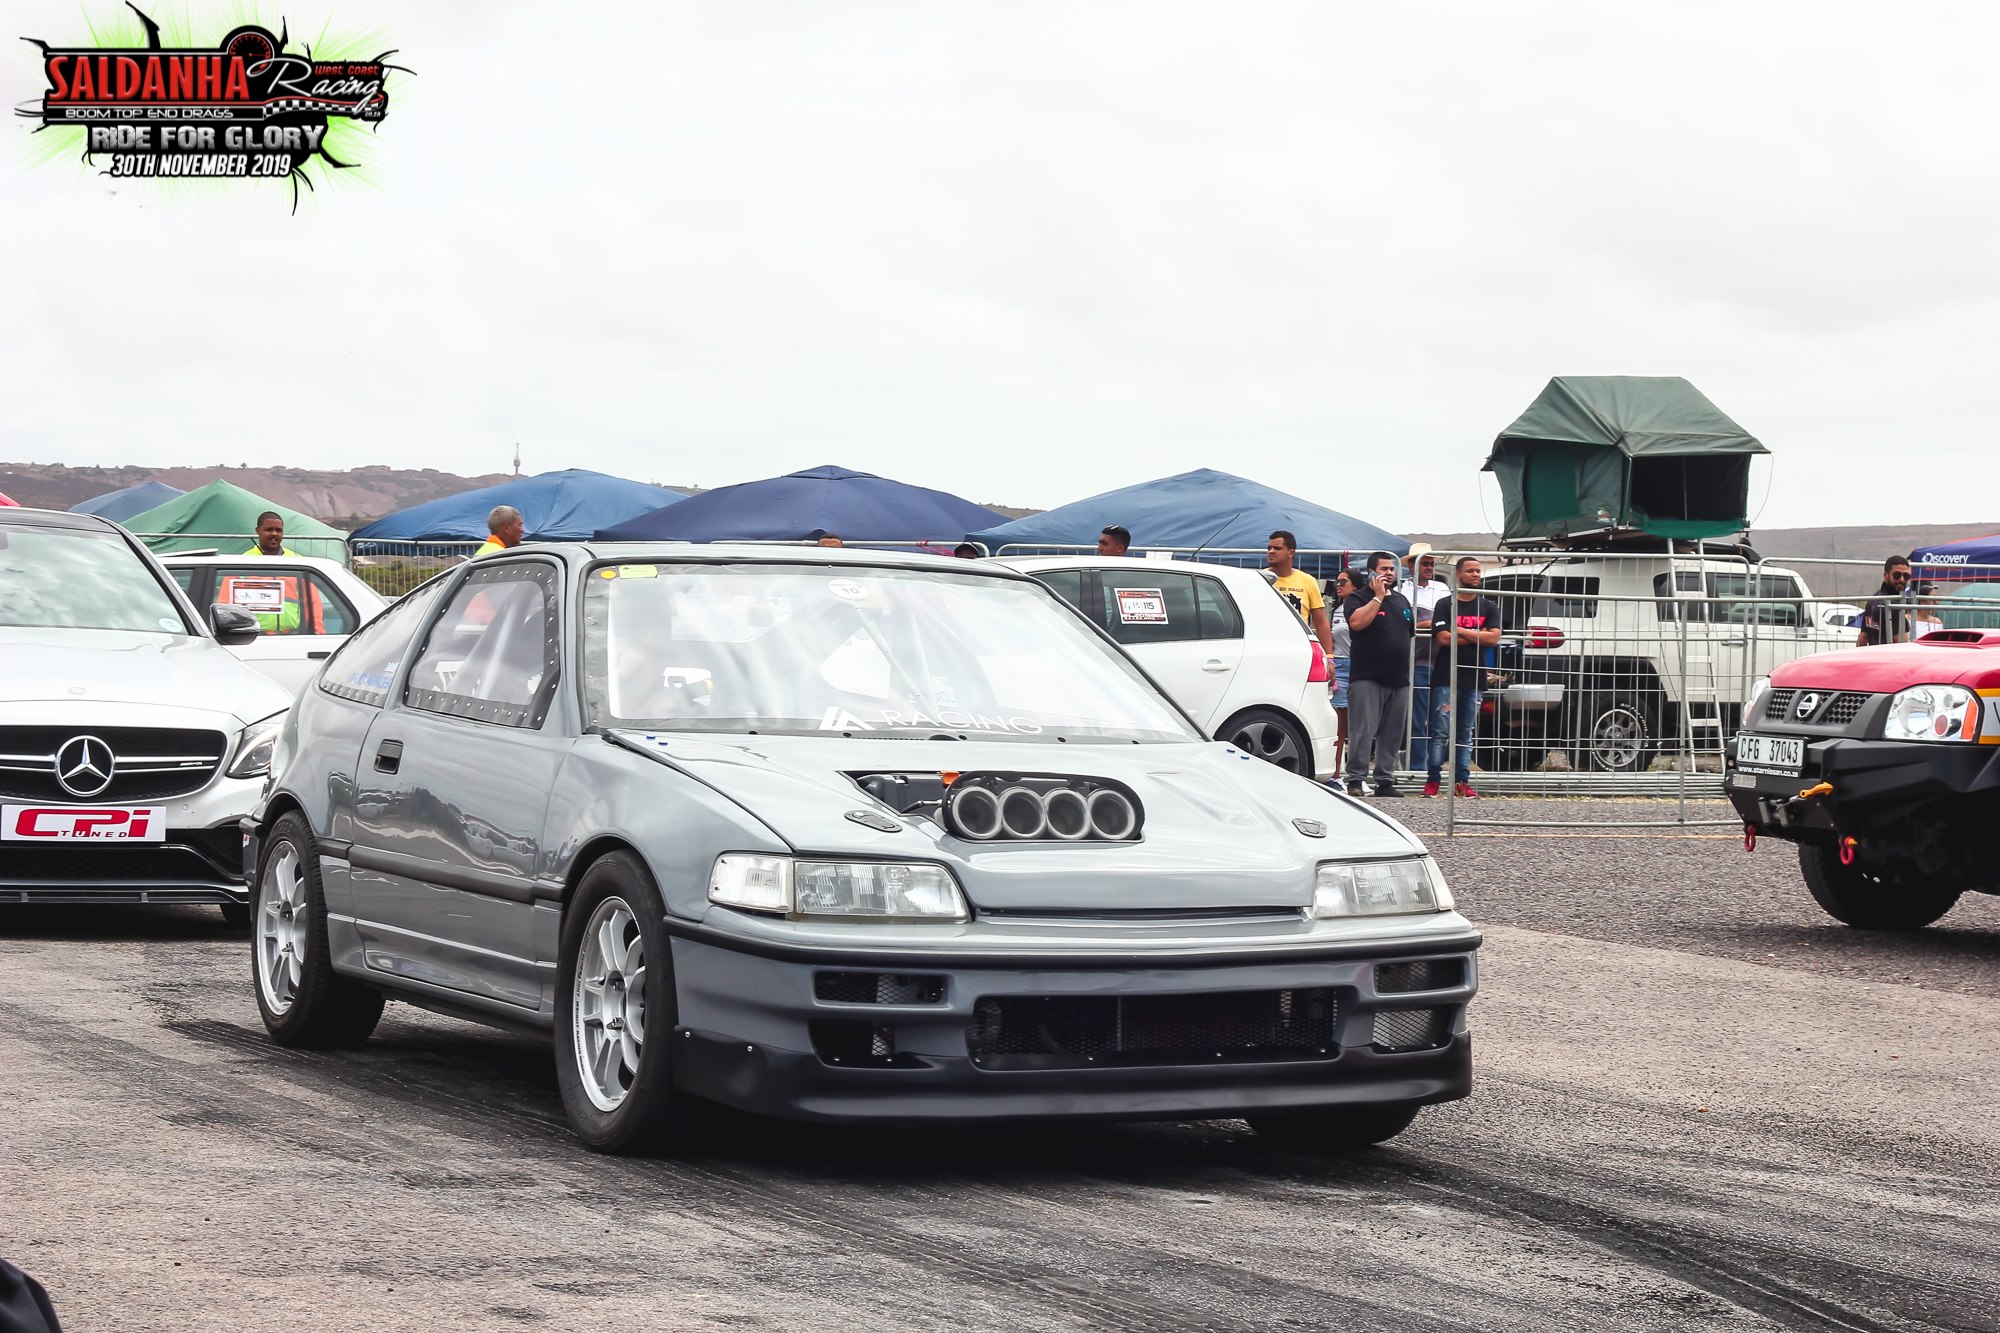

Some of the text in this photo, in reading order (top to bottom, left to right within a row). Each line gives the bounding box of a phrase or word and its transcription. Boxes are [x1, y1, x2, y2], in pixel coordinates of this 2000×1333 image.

[1922, 552, 1970, 565] Discovery
[880, 709, 1043, 734] RACING
[1740, 737, 1799, 764] CFG 37043
[61, 830, 128, 838] TUNED
